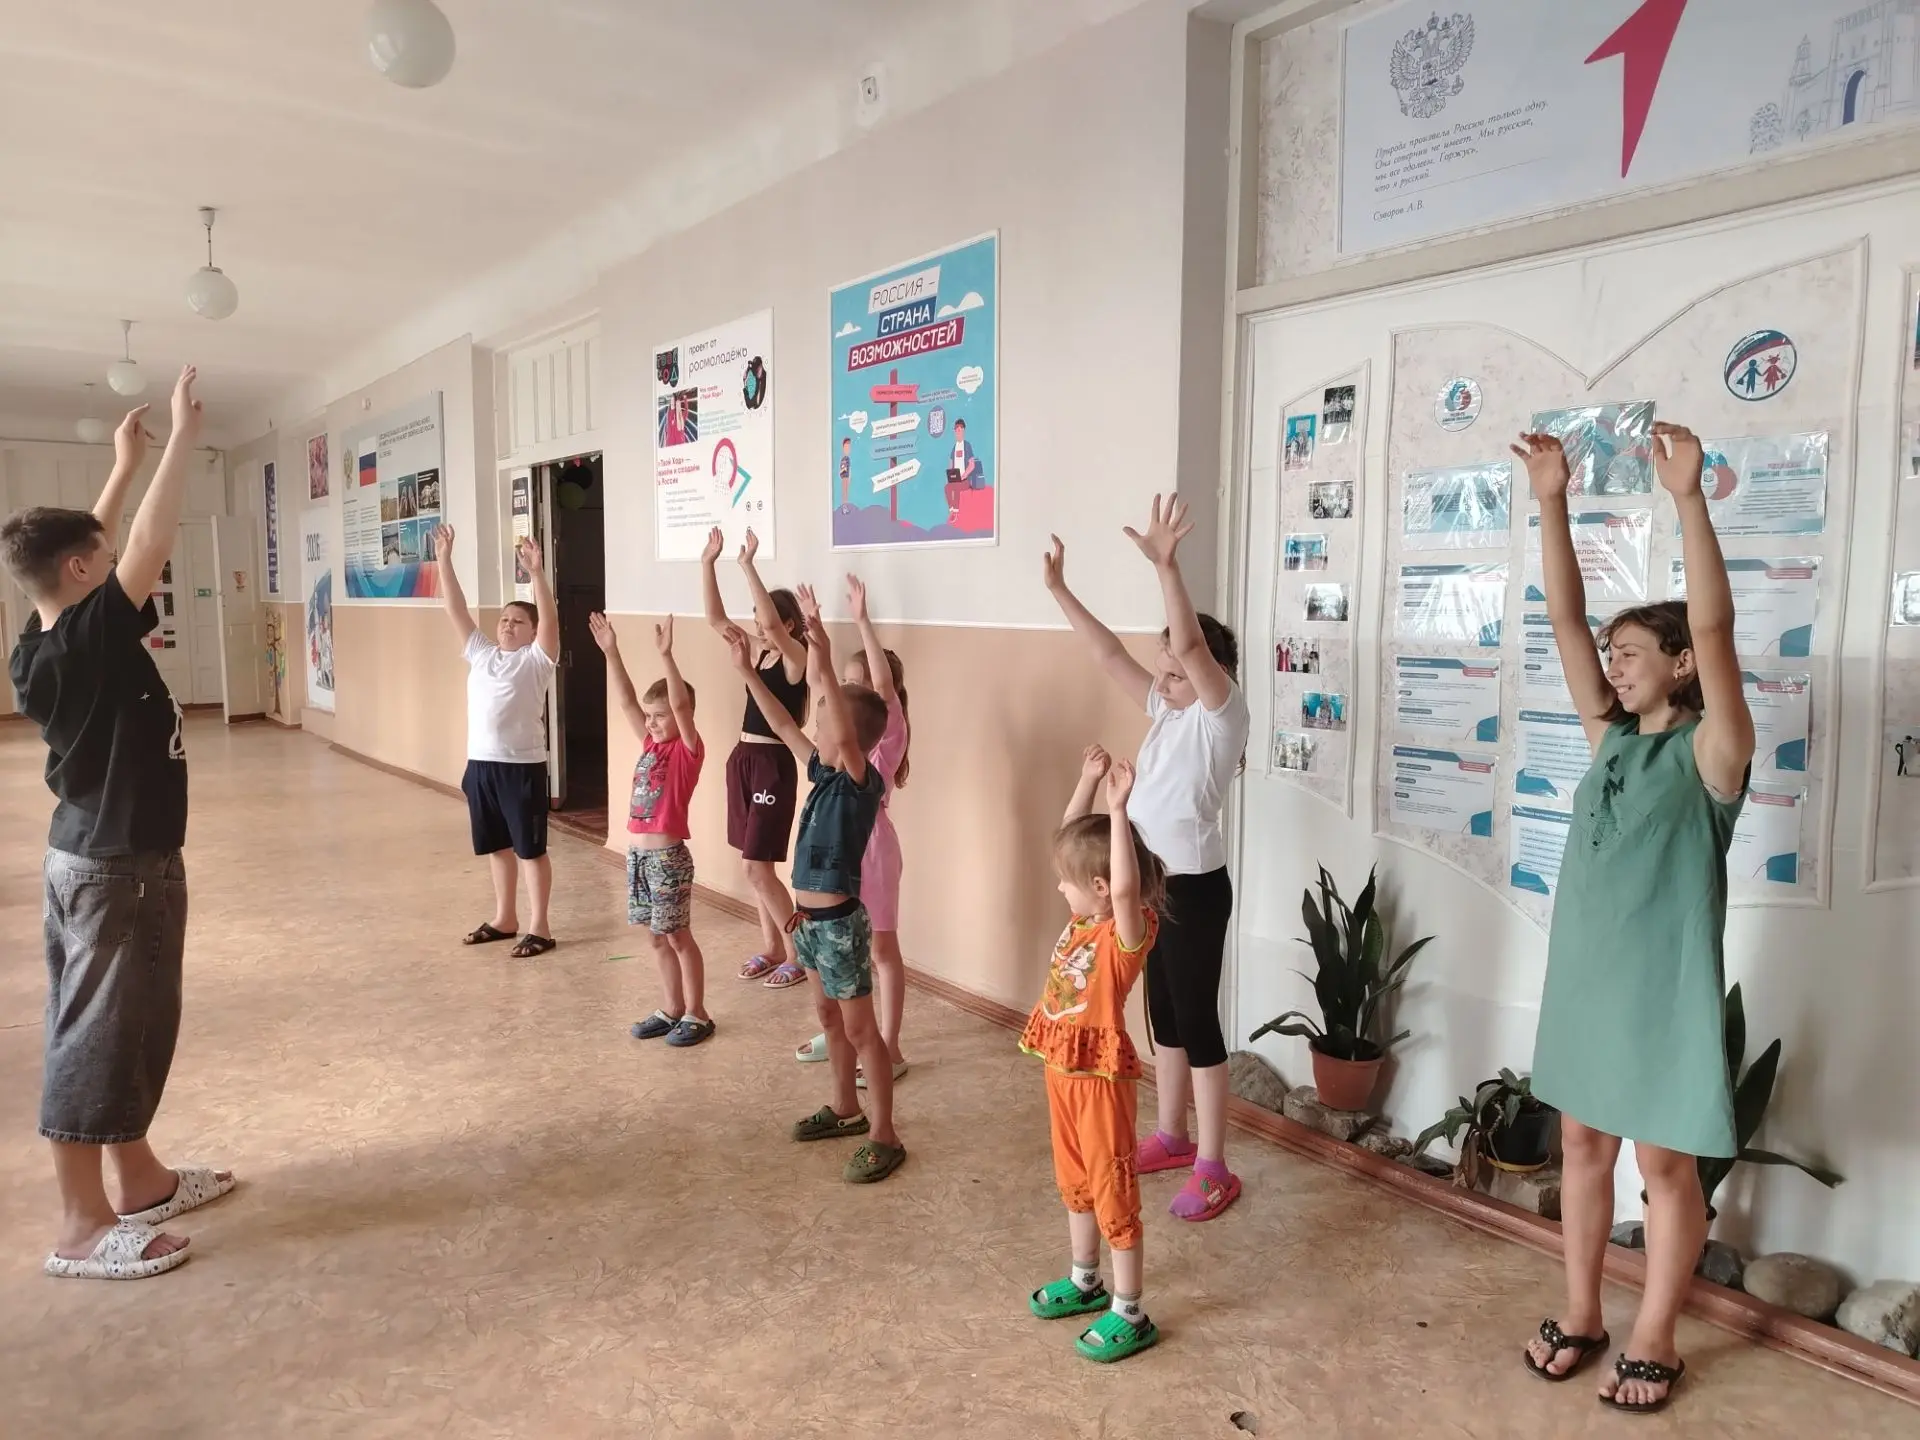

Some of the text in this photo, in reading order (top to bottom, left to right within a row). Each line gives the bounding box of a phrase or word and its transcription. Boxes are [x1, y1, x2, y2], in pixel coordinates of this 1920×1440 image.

[1453, 119, 1485, 134] Россию
[1488, 108, 1522, 124] только
[1375, 159, 1391, 170] Она
[1478, 129, 1495, 140] Мы
[1373, 208, 1404, 222] Суворов
[873, 277, 923, 308] РОССИЯ
[880, 304, 930, 333] СТРАНА
[689, 339, 717, 356] проект от
[851, 320, 957, 367] ВОЗМОЖНОСТЕЙ
[753, 789, 776, 805] alo
